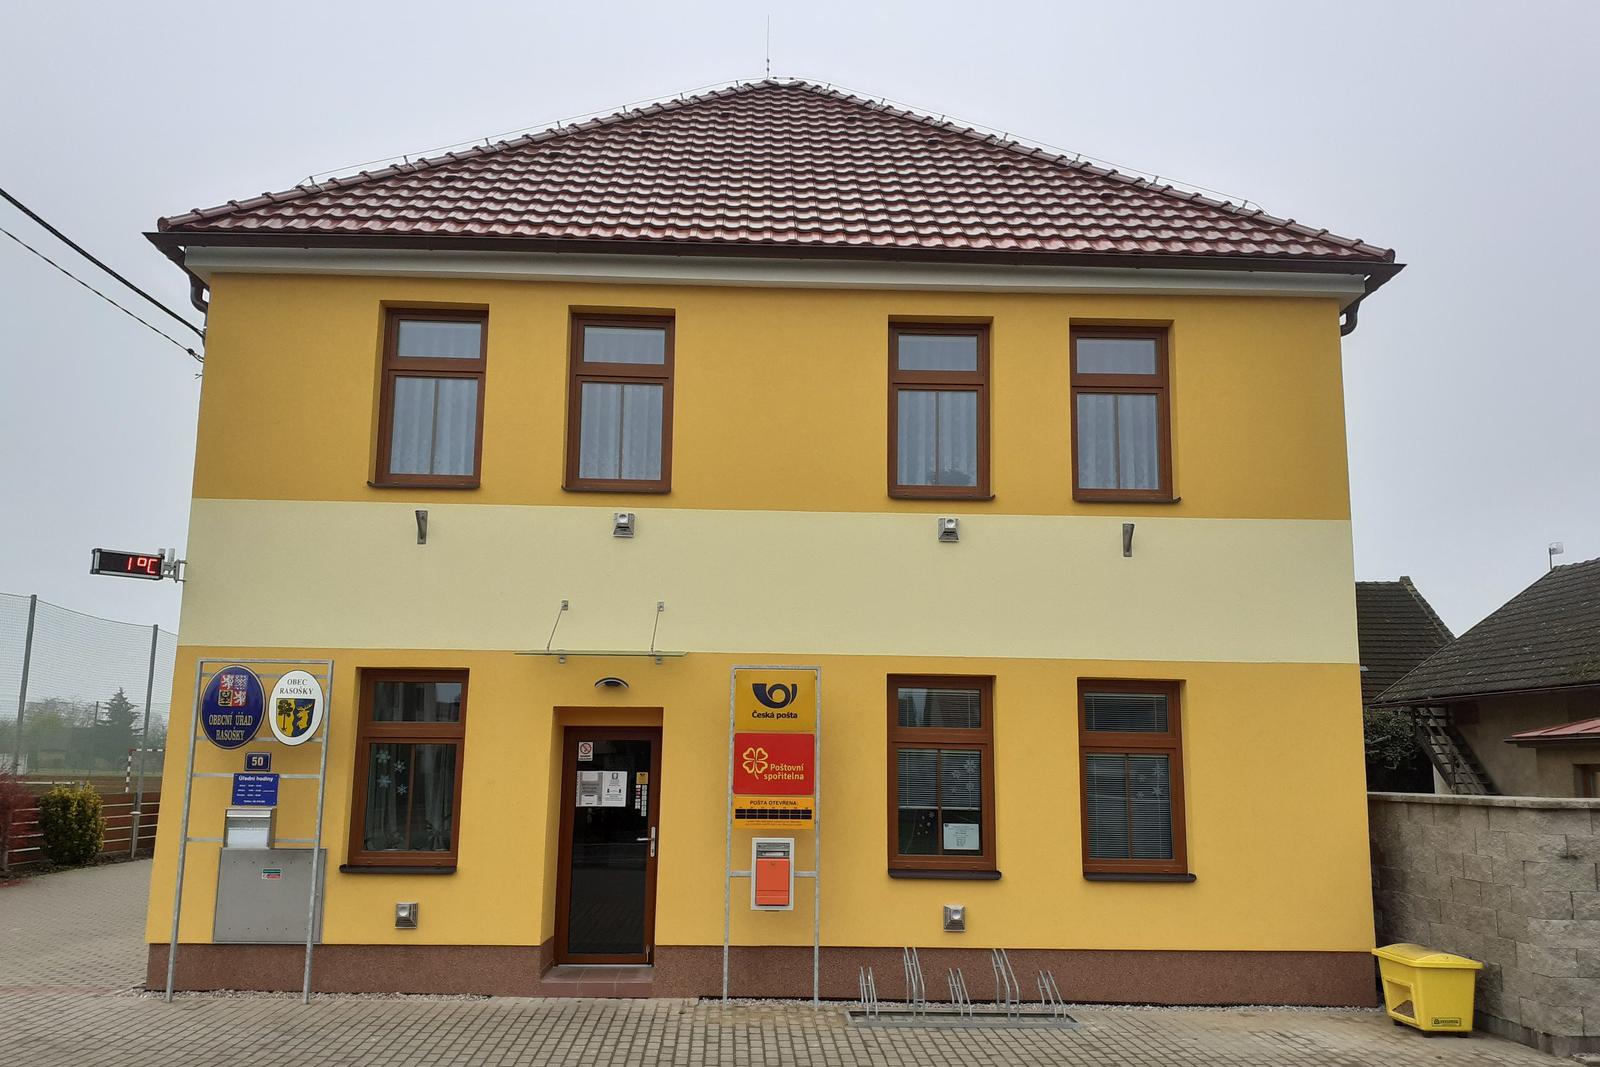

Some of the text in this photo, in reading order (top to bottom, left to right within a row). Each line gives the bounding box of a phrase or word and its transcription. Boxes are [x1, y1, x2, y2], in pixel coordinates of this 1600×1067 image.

[279, 686, 314, 695] RASOŠKY
[209, 712, 253, 726] OBECNÍ ÚŘAD
[752, 709, 798, 720] Česká pošta
[216, 728, 245, 740] RASOŠKY
[251, 756, 264, 767] 50
[770, 763, 804, 772] Poštovní
[256, 775, 274, 783] hodiny
[763, 772, 804, 781] spořitelna
